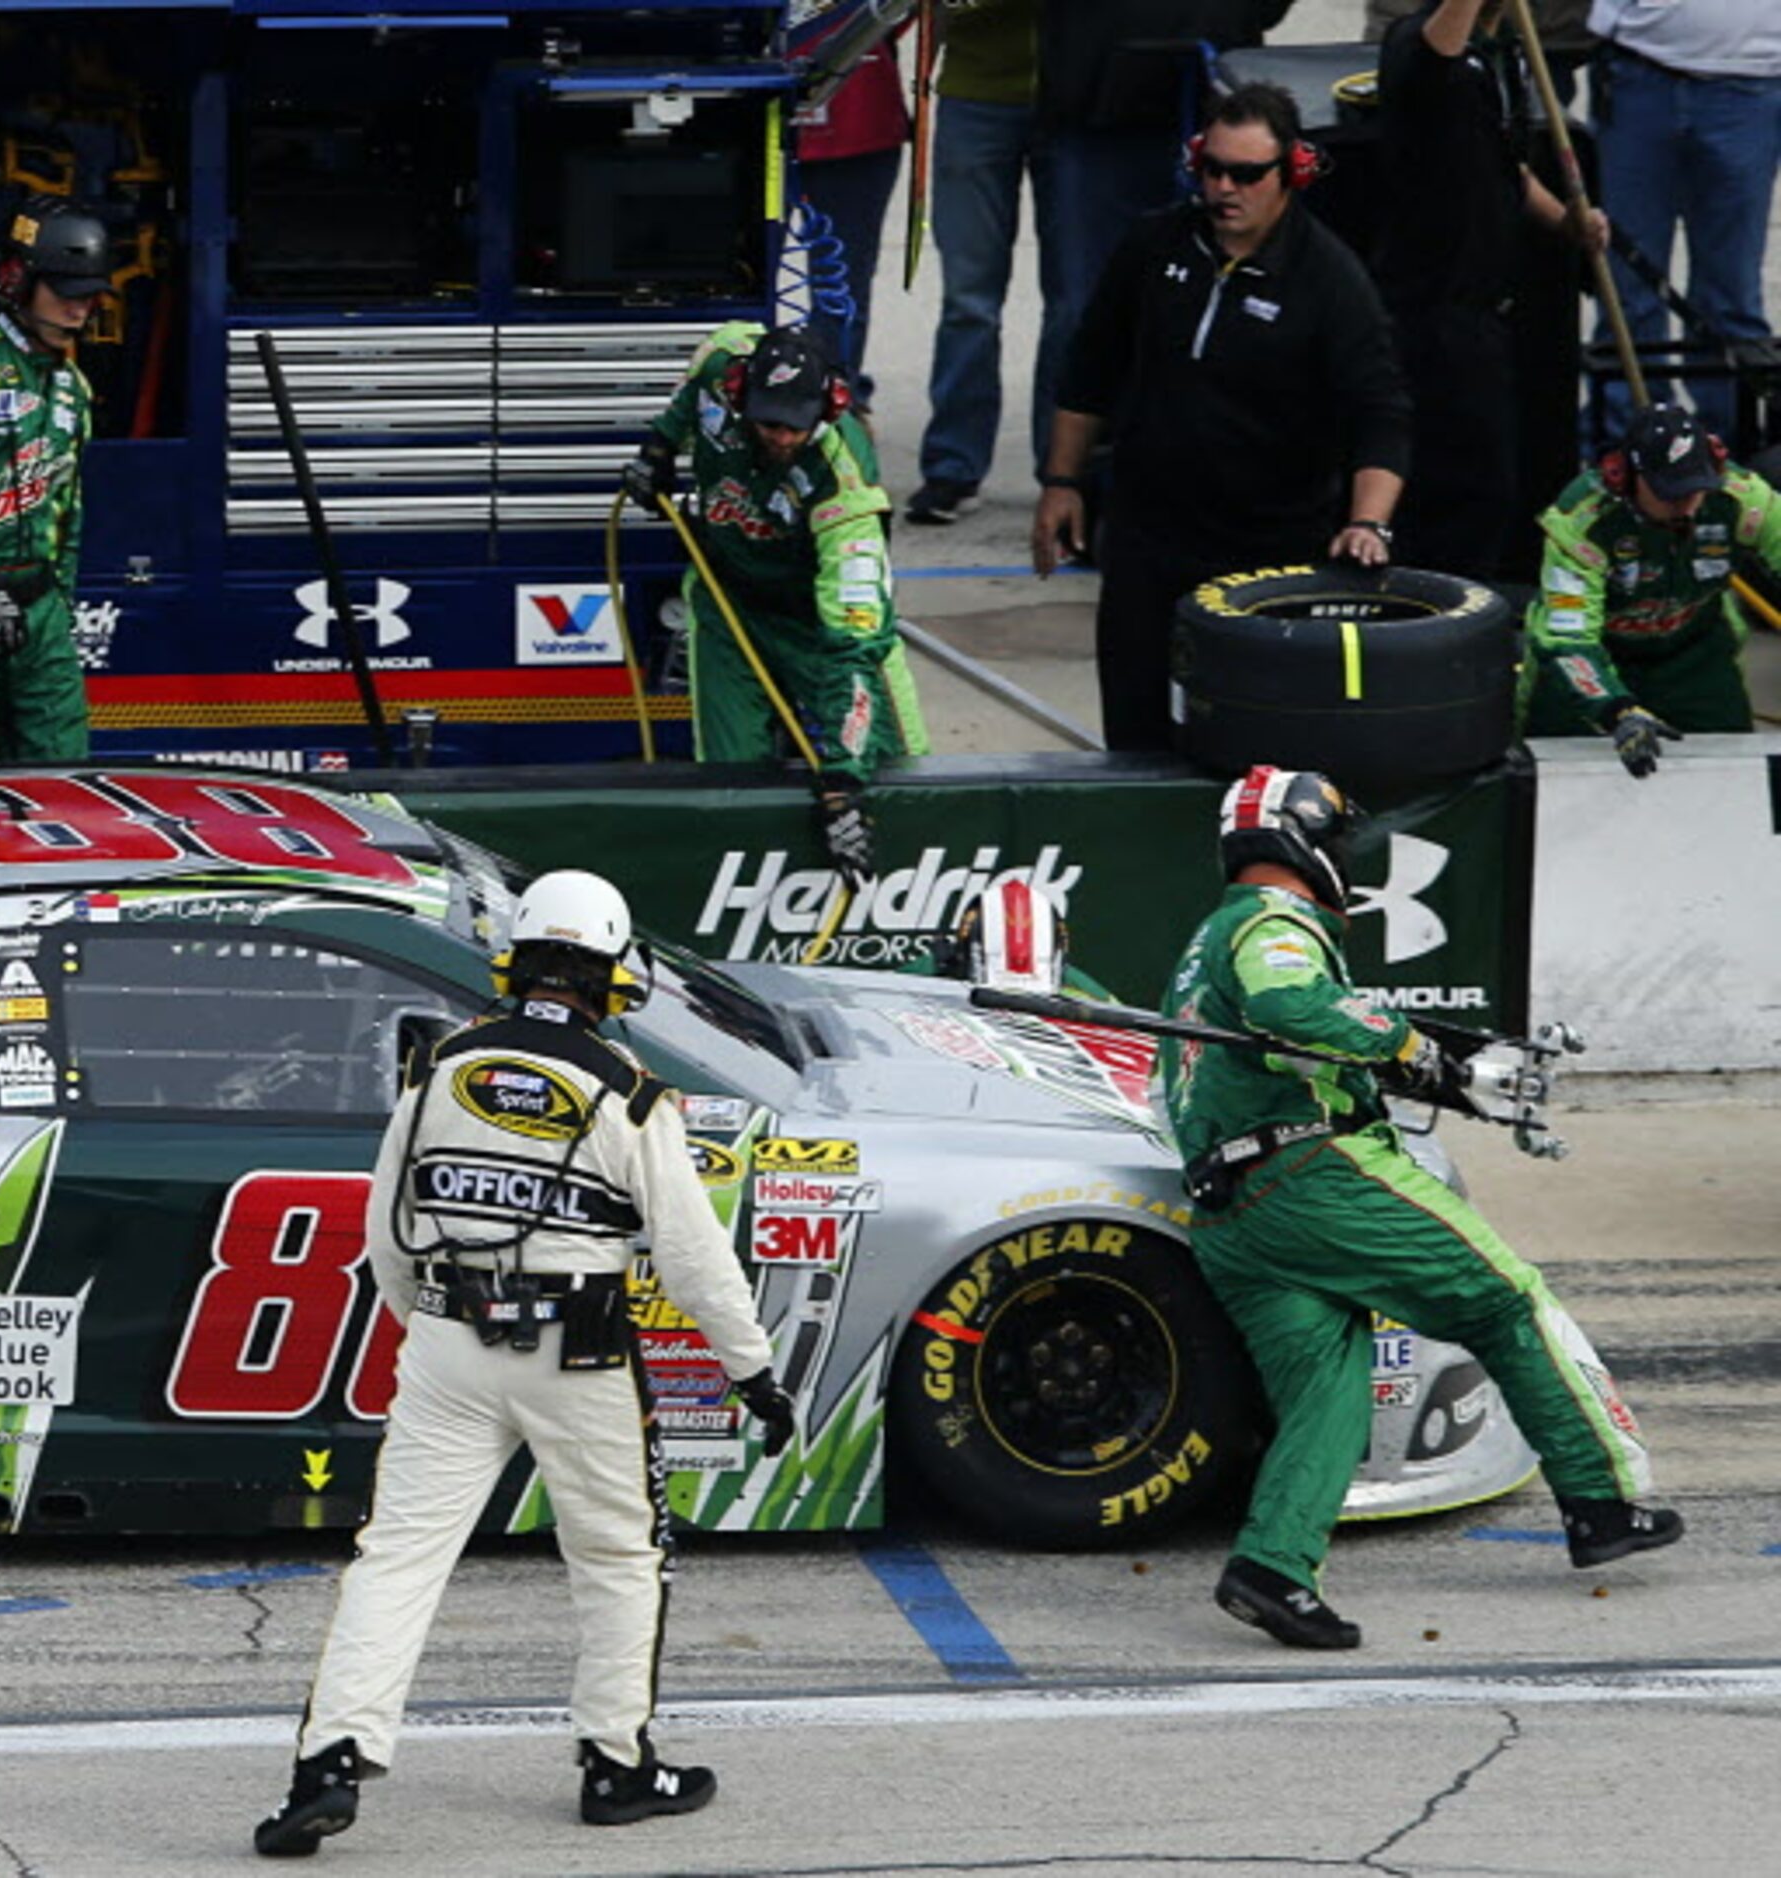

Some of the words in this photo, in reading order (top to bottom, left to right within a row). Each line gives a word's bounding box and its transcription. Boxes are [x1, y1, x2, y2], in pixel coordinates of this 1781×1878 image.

[531, 640, 610, 654] Valvoline
[273, 659, 342, 672] UNDER
[496, 1086, 547, 1113] Sprint
[430, 1164, 590, 1225] OFFICIAL
[757, 1178, 833, 1207] Holley
[753, 1216, 836, 1260] 3M
[923, 1224, 1133, 1402] GOODYEAR
[1098, 1431, 1213, 1527] EAGLE
